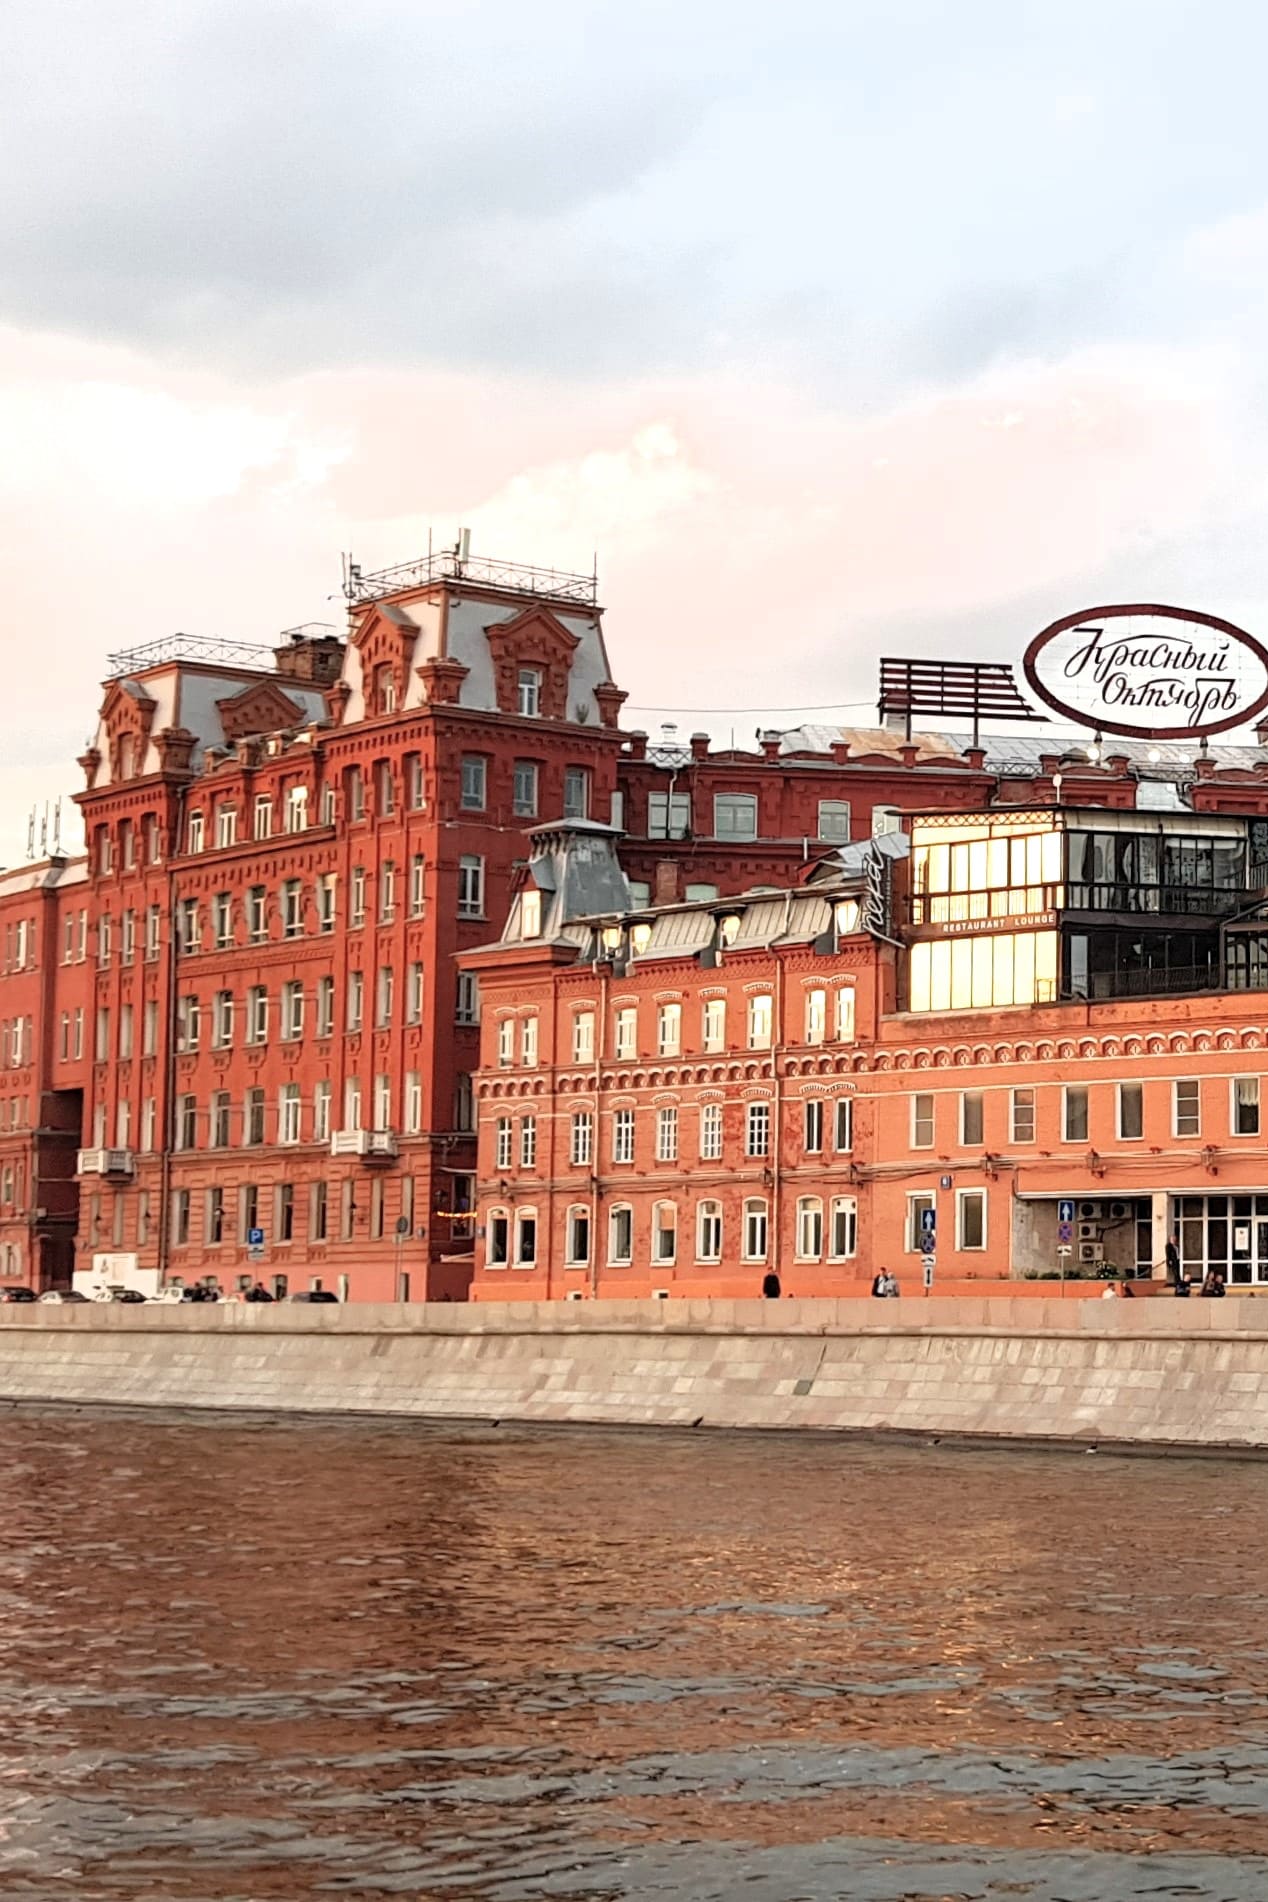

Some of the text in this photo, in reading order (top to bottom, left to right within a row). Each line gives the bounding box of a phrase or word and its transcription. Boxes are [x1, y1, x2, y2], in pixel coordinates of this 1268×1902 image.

[1064, 628, 1230, 683] Красный
[1102, 672, 1242, 727] Октябрь
[943, 914, 1055, 932] RESTAURANT LOUNGE
